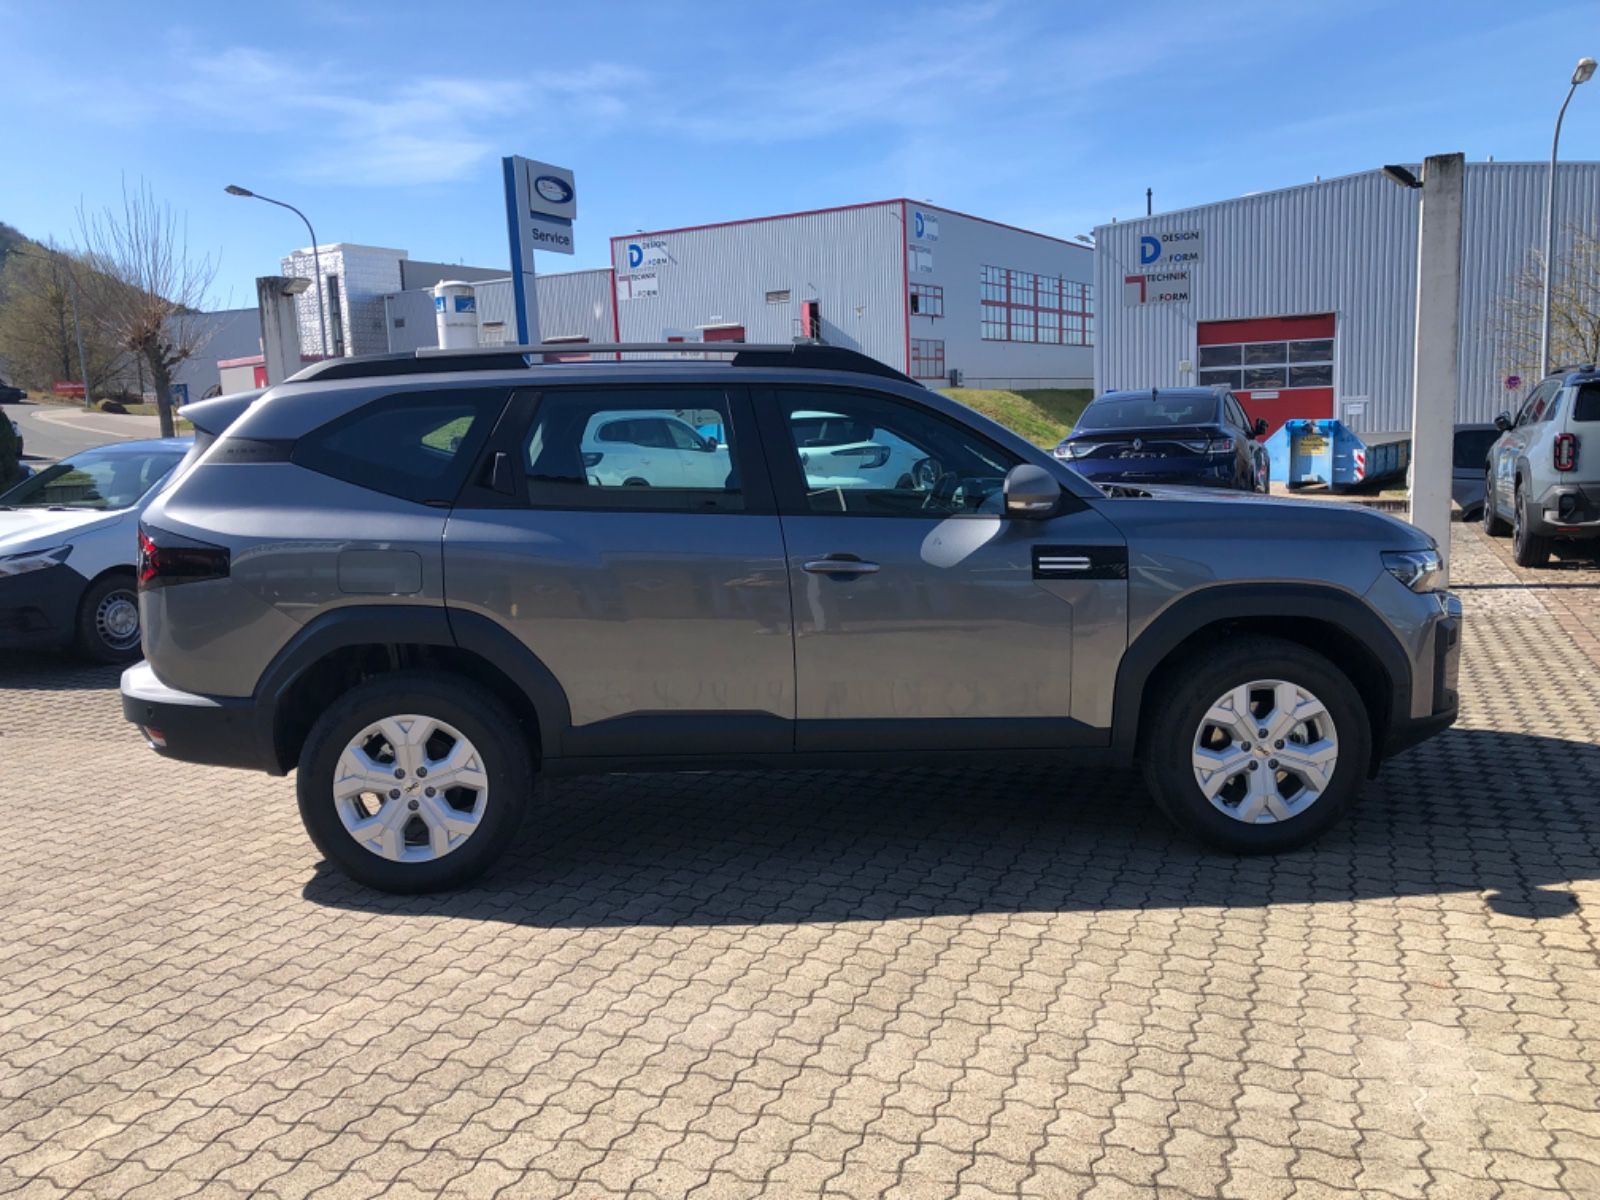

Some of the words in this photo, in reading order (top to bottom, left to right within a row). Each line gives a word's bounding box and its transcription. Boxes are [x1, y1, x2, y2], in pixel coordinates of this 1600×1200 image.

[532, 228, 570, 245] Service
[1162, 231, 1199, 242] DESIGN
[1169, 252, 1199, 263] FORM
[1147, 271, 1188, 282] TECHNIK
[1160, 292, 1188, 302] FORM
